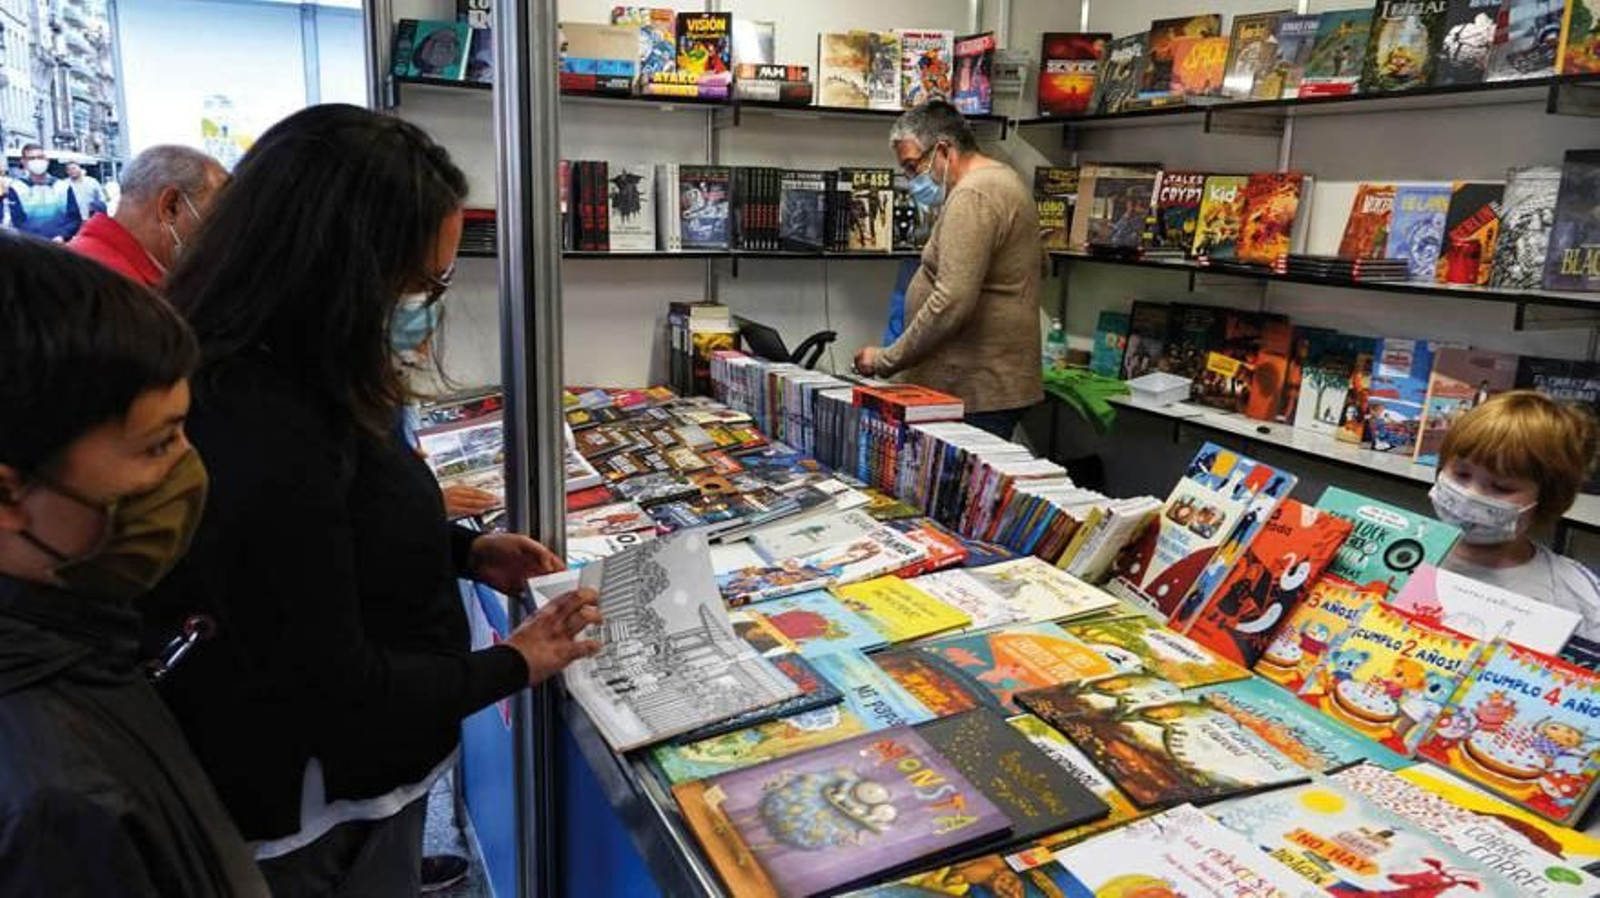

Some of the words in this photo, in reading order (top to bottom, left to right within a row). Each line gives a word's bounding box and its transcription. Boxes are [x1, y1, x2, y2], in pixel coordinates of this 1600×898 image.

[687, 17, 726, 31] VISIÓN
[1321, 600, 1358, 622] AÑOS!
[1351, 628, 1402, 651] ¡CUMPLO
[1401, 639, 1418, 658] 2
[1415, 648, 1461, 672] AÑOS!
[1477, 670, 1542, 698] ¡CUMPLO
[1544, 686, 1562, 706] 4
[1296, 832, 1324, 849] NO
[1328, 848, 1373, 873] HAY
[1463, 826, 1533, 860] CORRE
